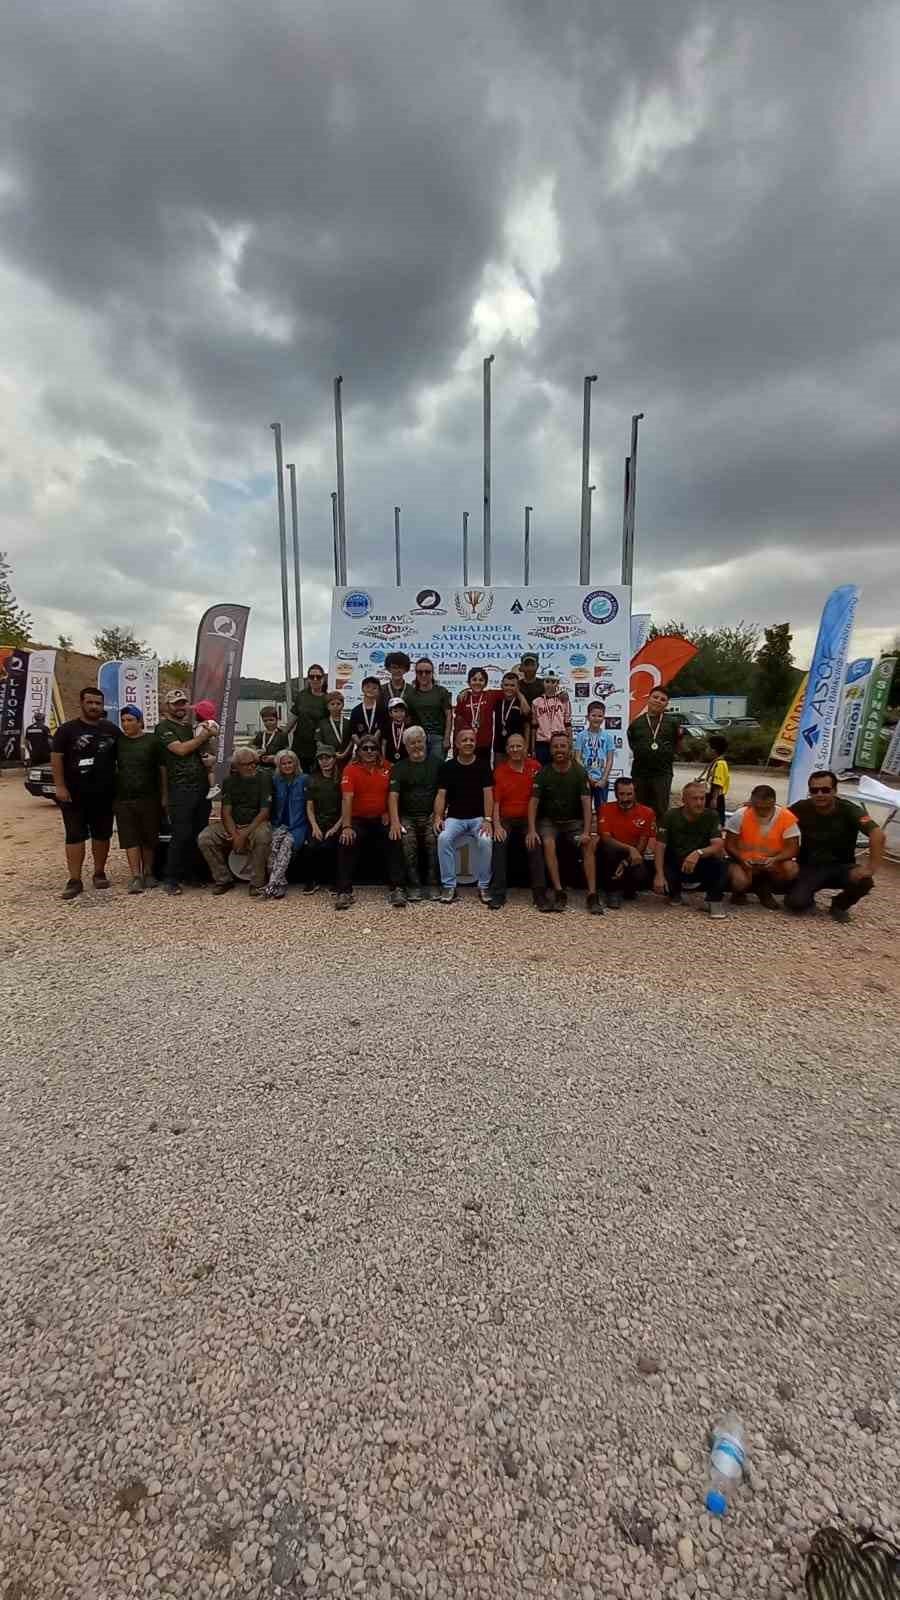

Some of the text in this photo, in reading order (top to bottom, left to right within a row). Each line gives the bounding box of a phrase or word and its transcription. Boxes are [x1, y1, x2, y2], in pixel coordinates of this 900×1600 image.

[526, 598, 556, 609] ASOF
[442, 624, 513, 632] ESBALDER
[351, 641, 395, 649] SAZAN
[446, 642, 524, 650] YAKALAMA
[810, 645, 838, 717] ASOF
